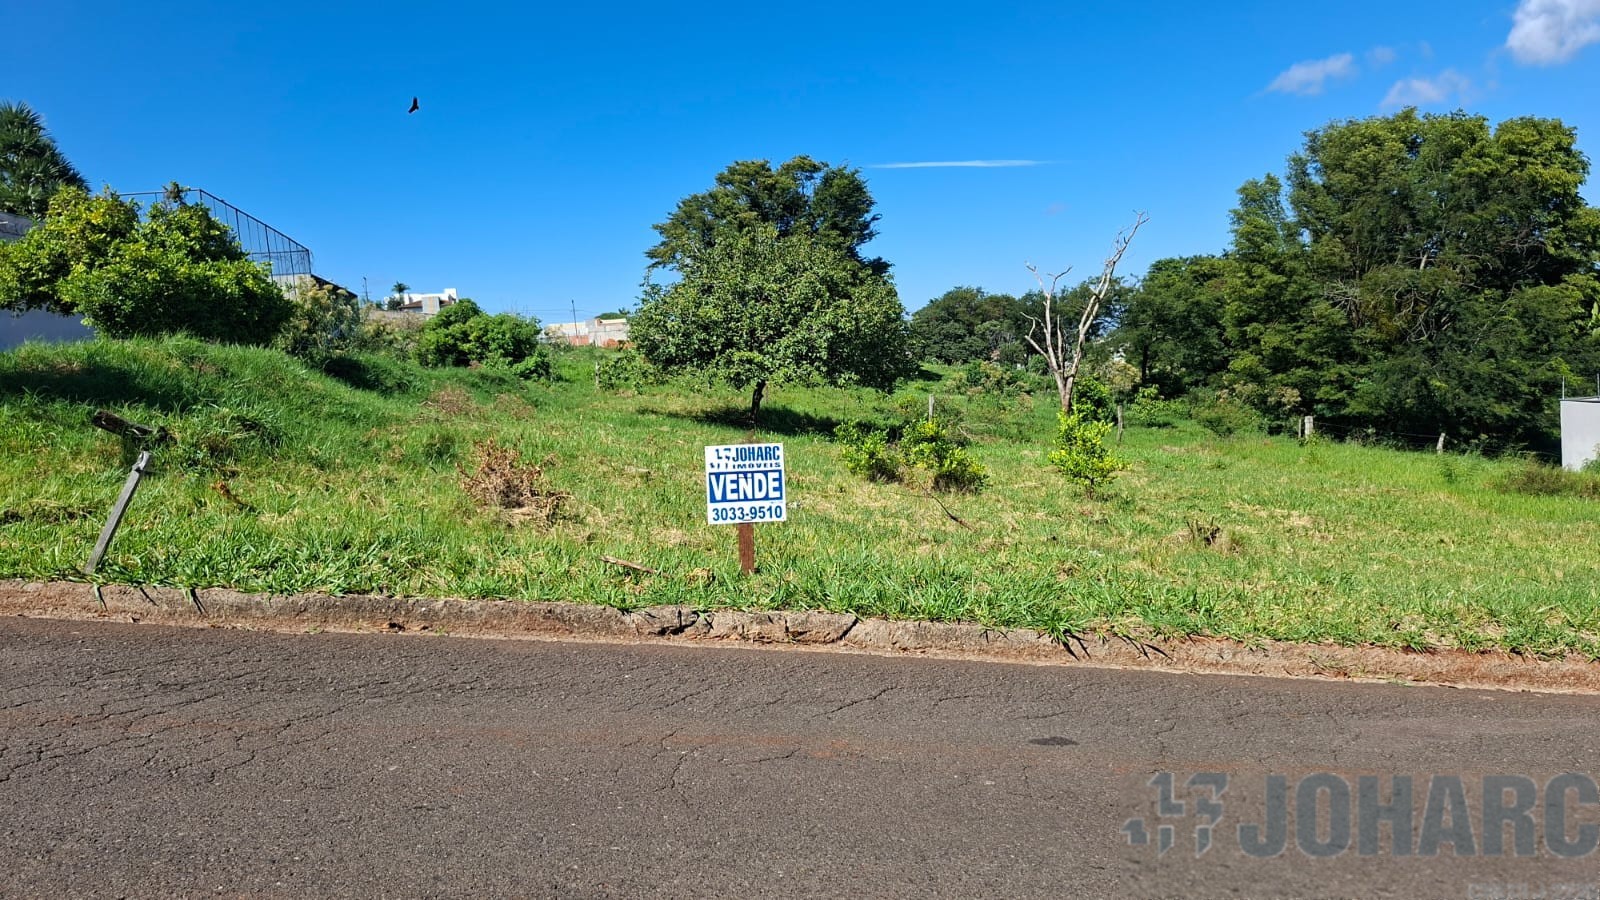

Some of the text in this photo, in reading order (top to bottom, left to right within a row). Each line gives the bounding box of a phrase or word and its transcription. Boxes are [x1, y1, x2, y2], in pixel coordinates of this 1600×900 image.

[732, 445, 780, 462] JOHARC
[710, 471, 781, 501] VENDE
[712, 505, 783, 521] 3033-9510
